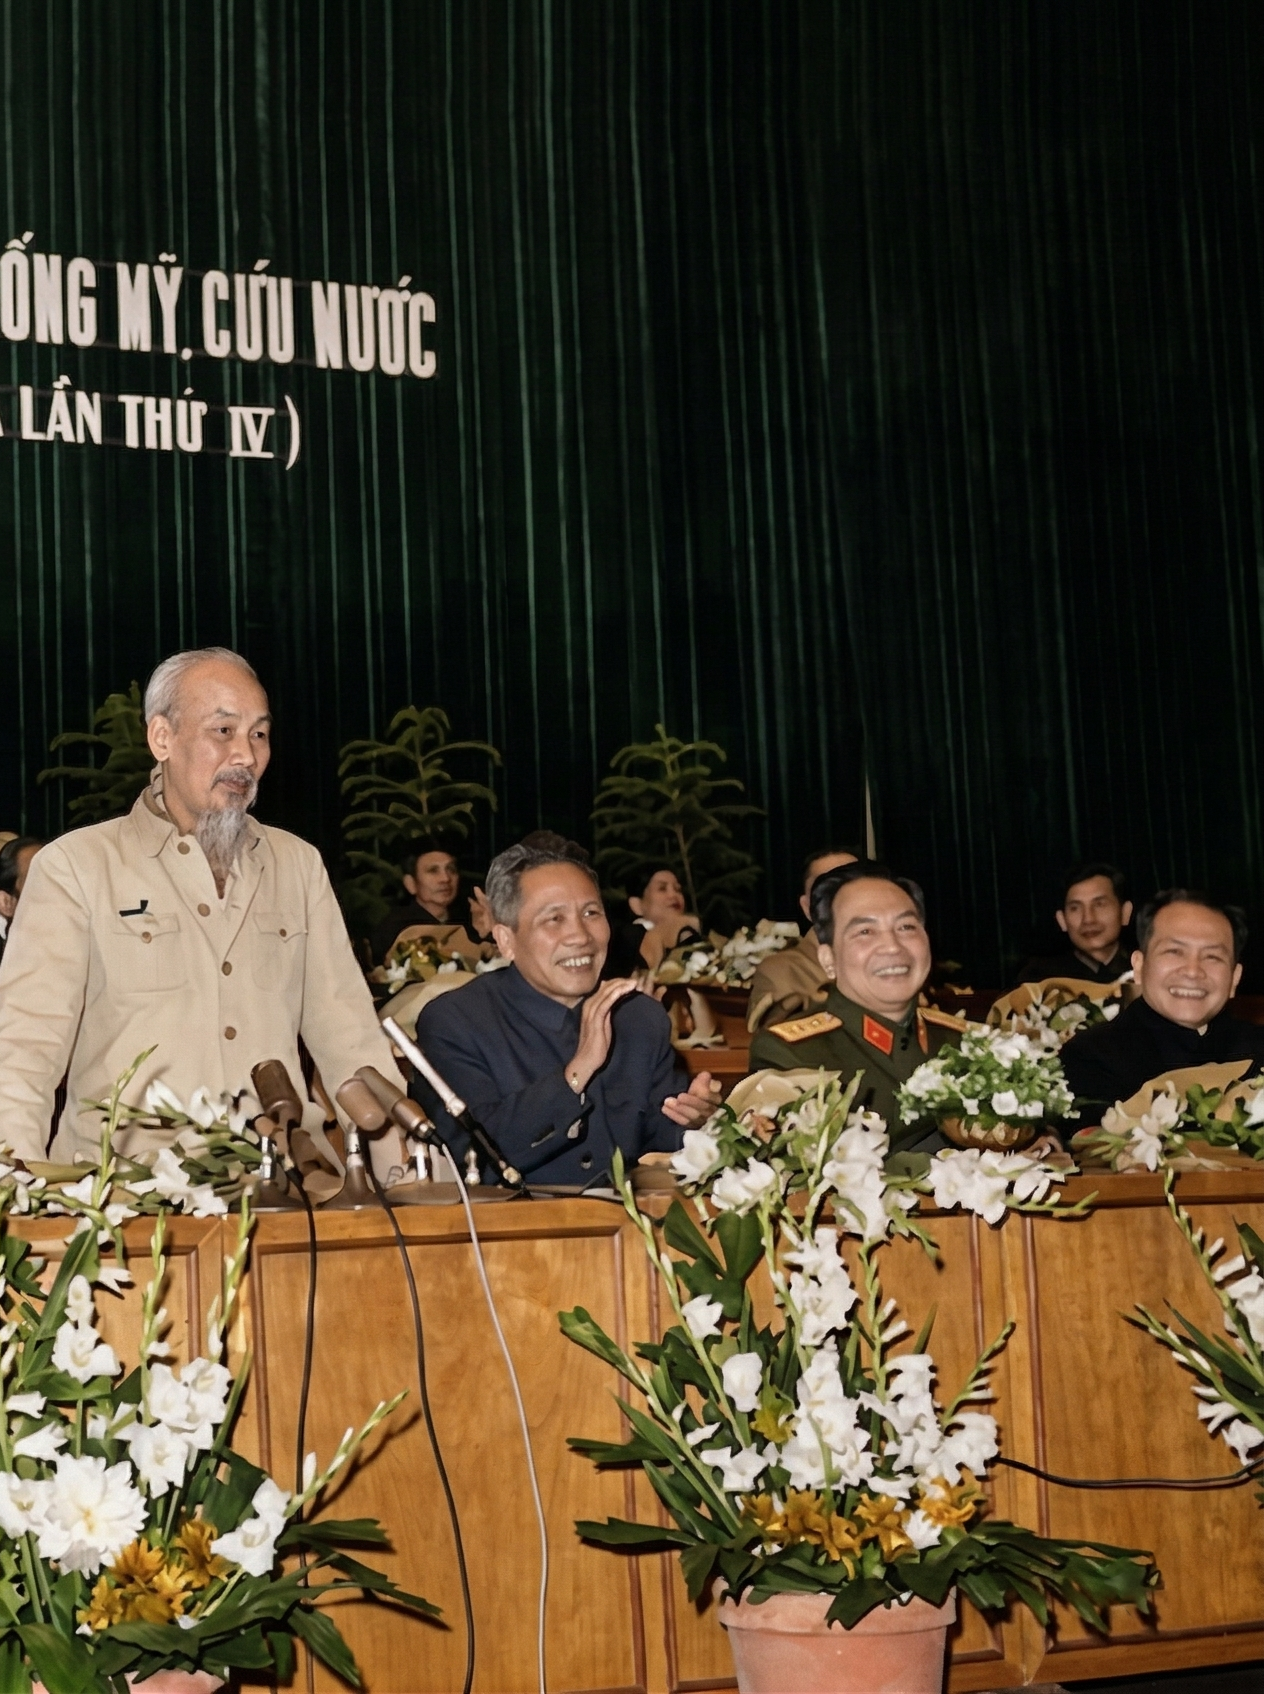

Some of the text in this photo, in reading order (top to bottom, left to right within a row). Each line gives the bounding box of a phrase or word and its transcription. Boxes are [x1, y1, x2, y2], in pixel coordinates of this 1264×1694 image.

[201, 259, 296, 364] CỨU
[310, 275, 438, 379] NƯỚC
[117, 386, 209, 454] THỨ
